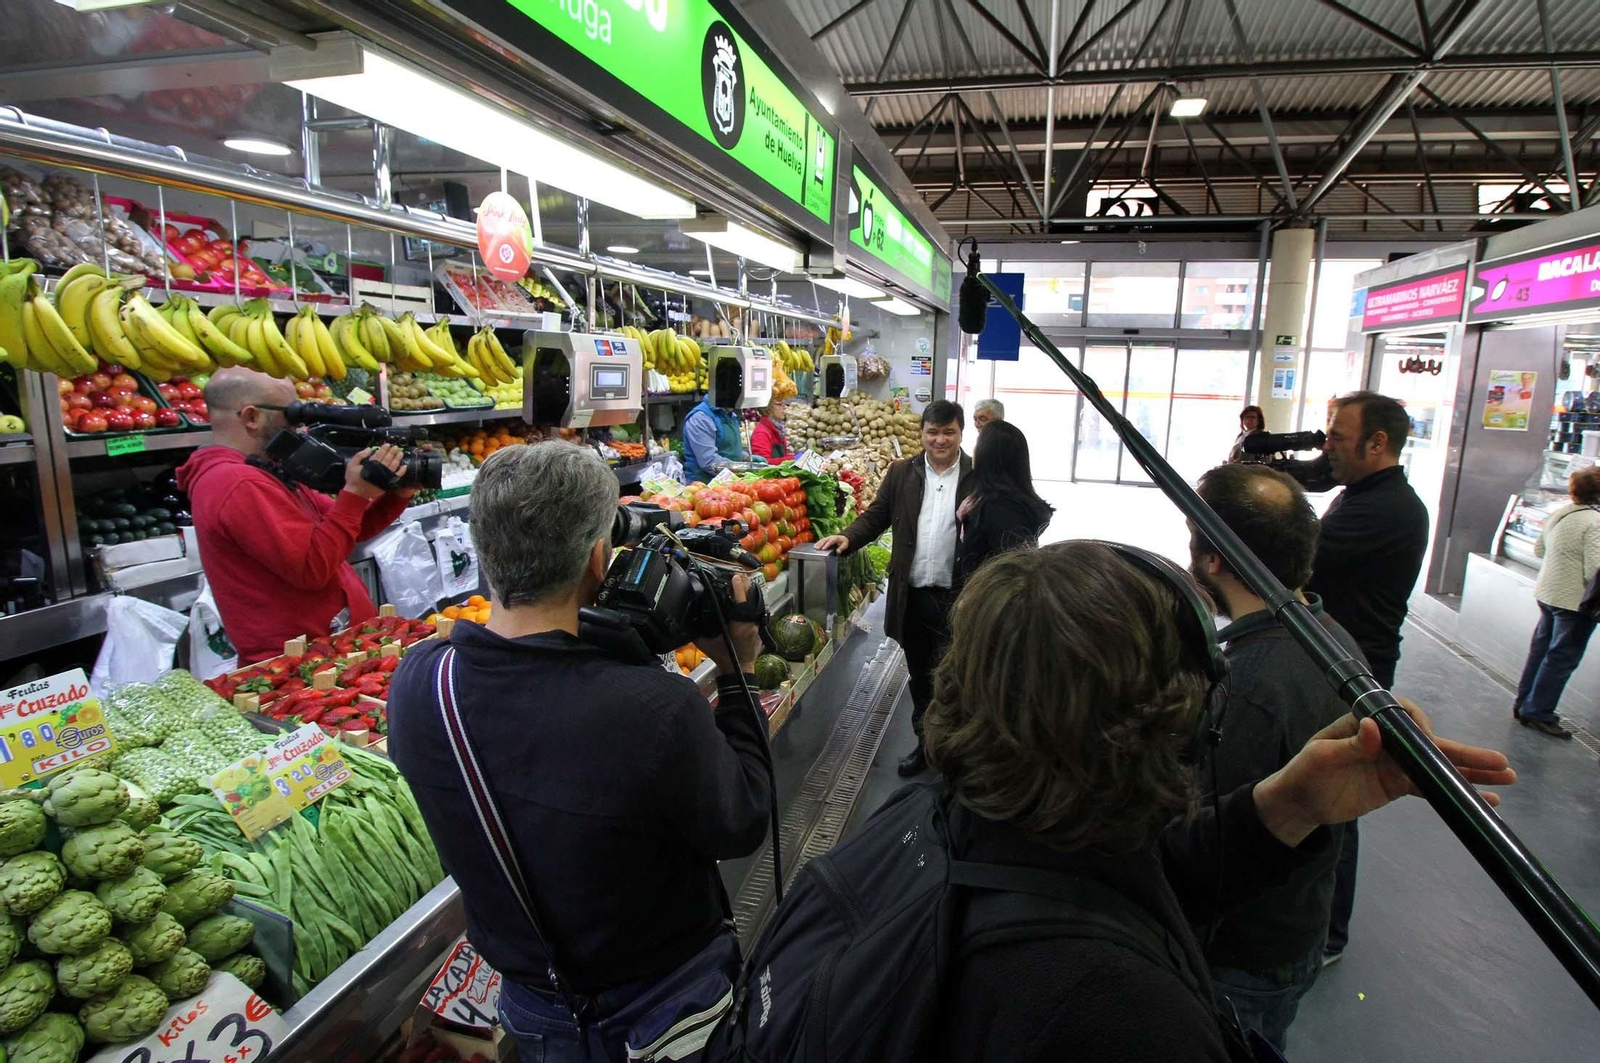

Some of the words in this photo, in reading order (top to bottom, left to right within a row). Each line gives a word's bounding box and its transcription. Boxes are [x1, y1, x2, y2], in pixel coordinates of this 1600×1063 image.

[750, 86, 803, 150] Ayuntamiento
[764, 130, 775, 153] de
[777, 142, 802, 175] Huelva
[7, 680, 51, 700] Frutas
[17, 684, 89, 718] Cruzado
[274, 732, 300, 750] Frutas
[283, 732, 325, 762] Cruzado
[39, 742, 106, 770] KILO
[309, 771, 349, 799] KILO
